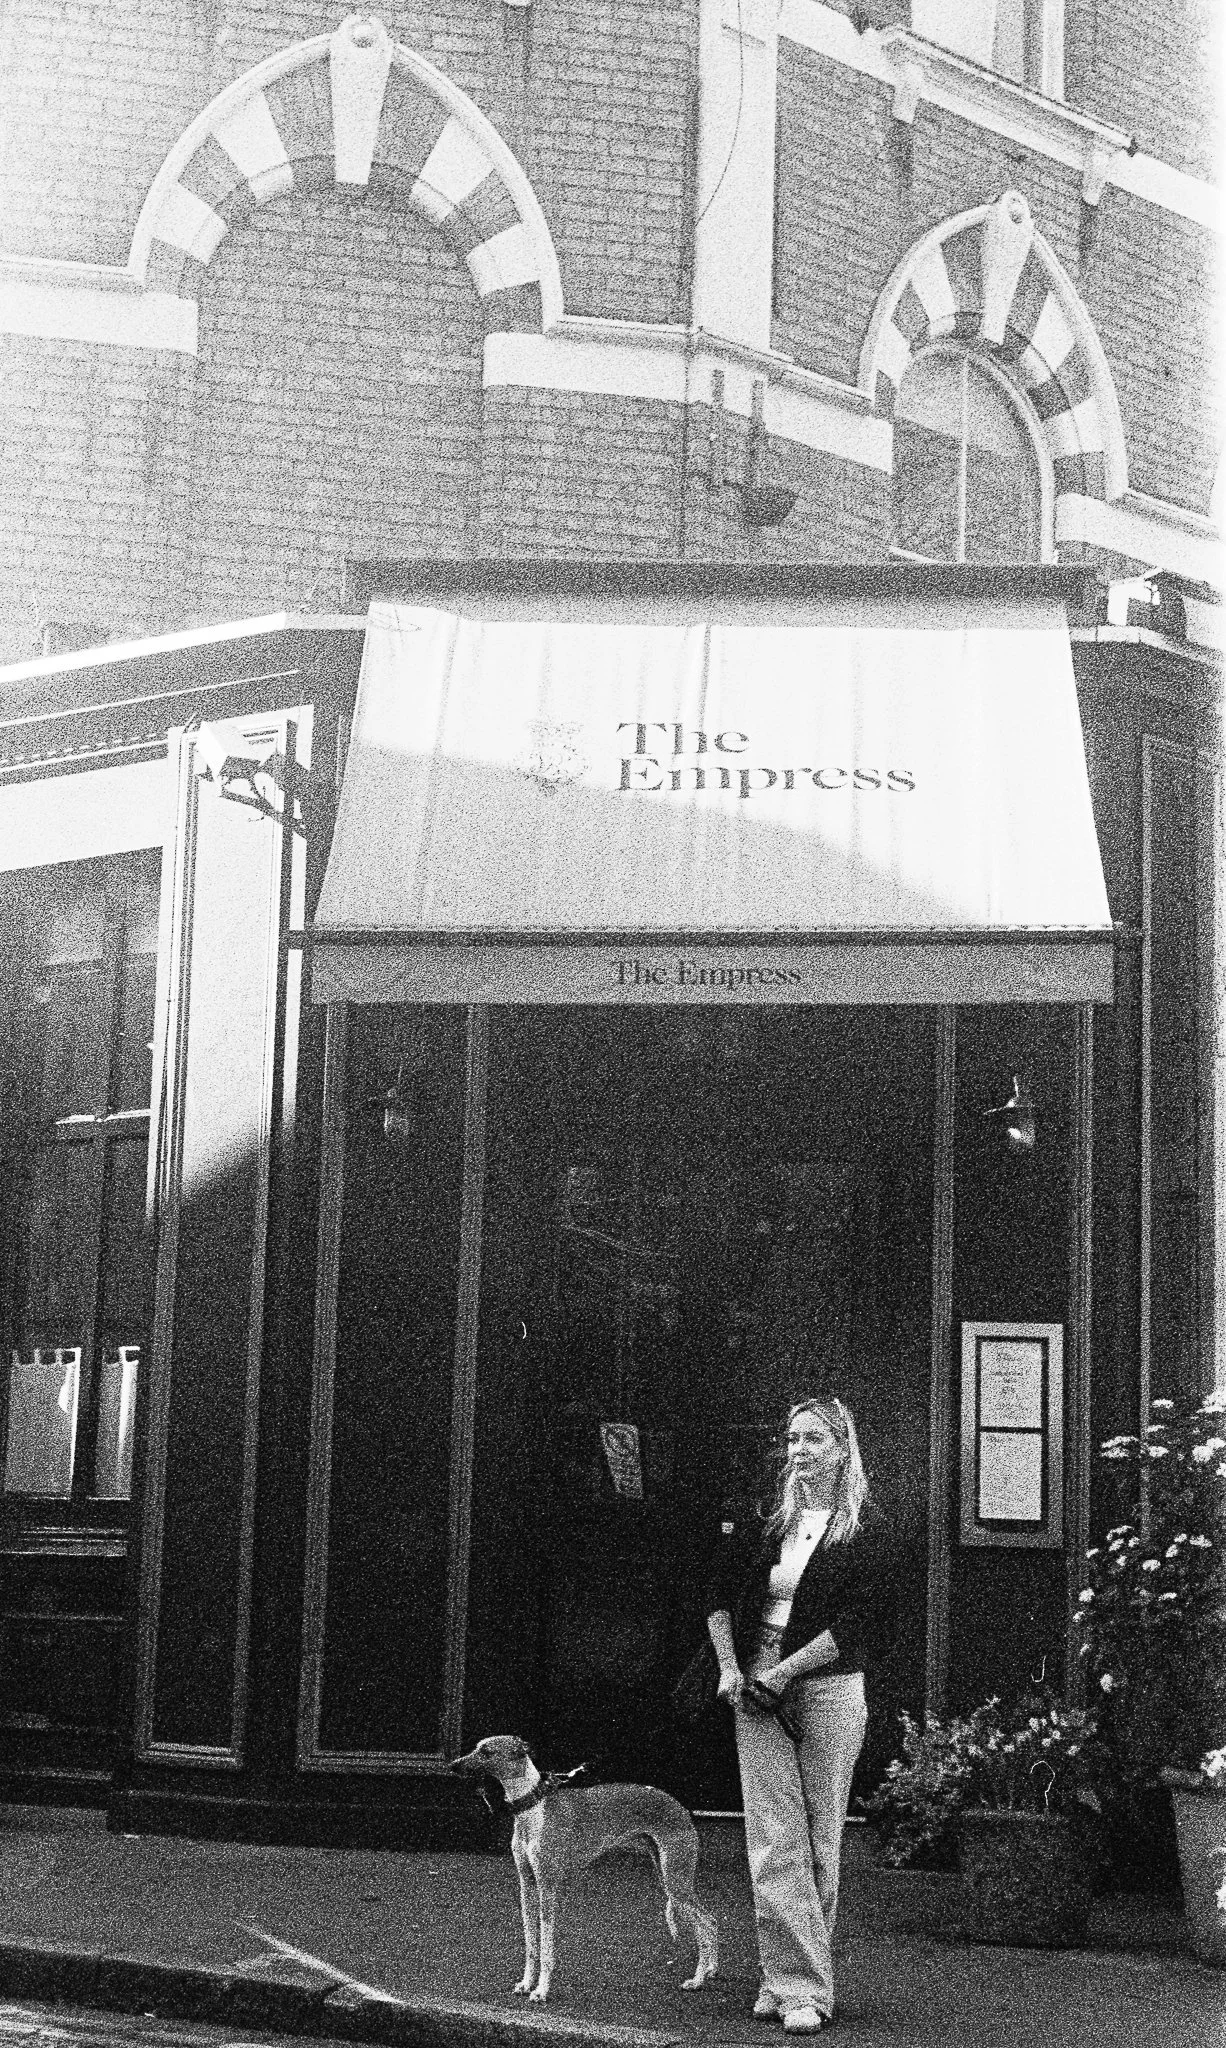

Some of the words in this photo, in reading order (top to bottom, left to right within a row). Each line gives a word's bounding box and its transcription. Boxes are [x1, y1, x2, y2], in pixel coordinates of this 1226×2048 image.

[616, 722, 750, 755] The
[615, 758, 916, 799] Empress
[611, 960, 667, 985] The
[679, 960, 802, 992] Empress
